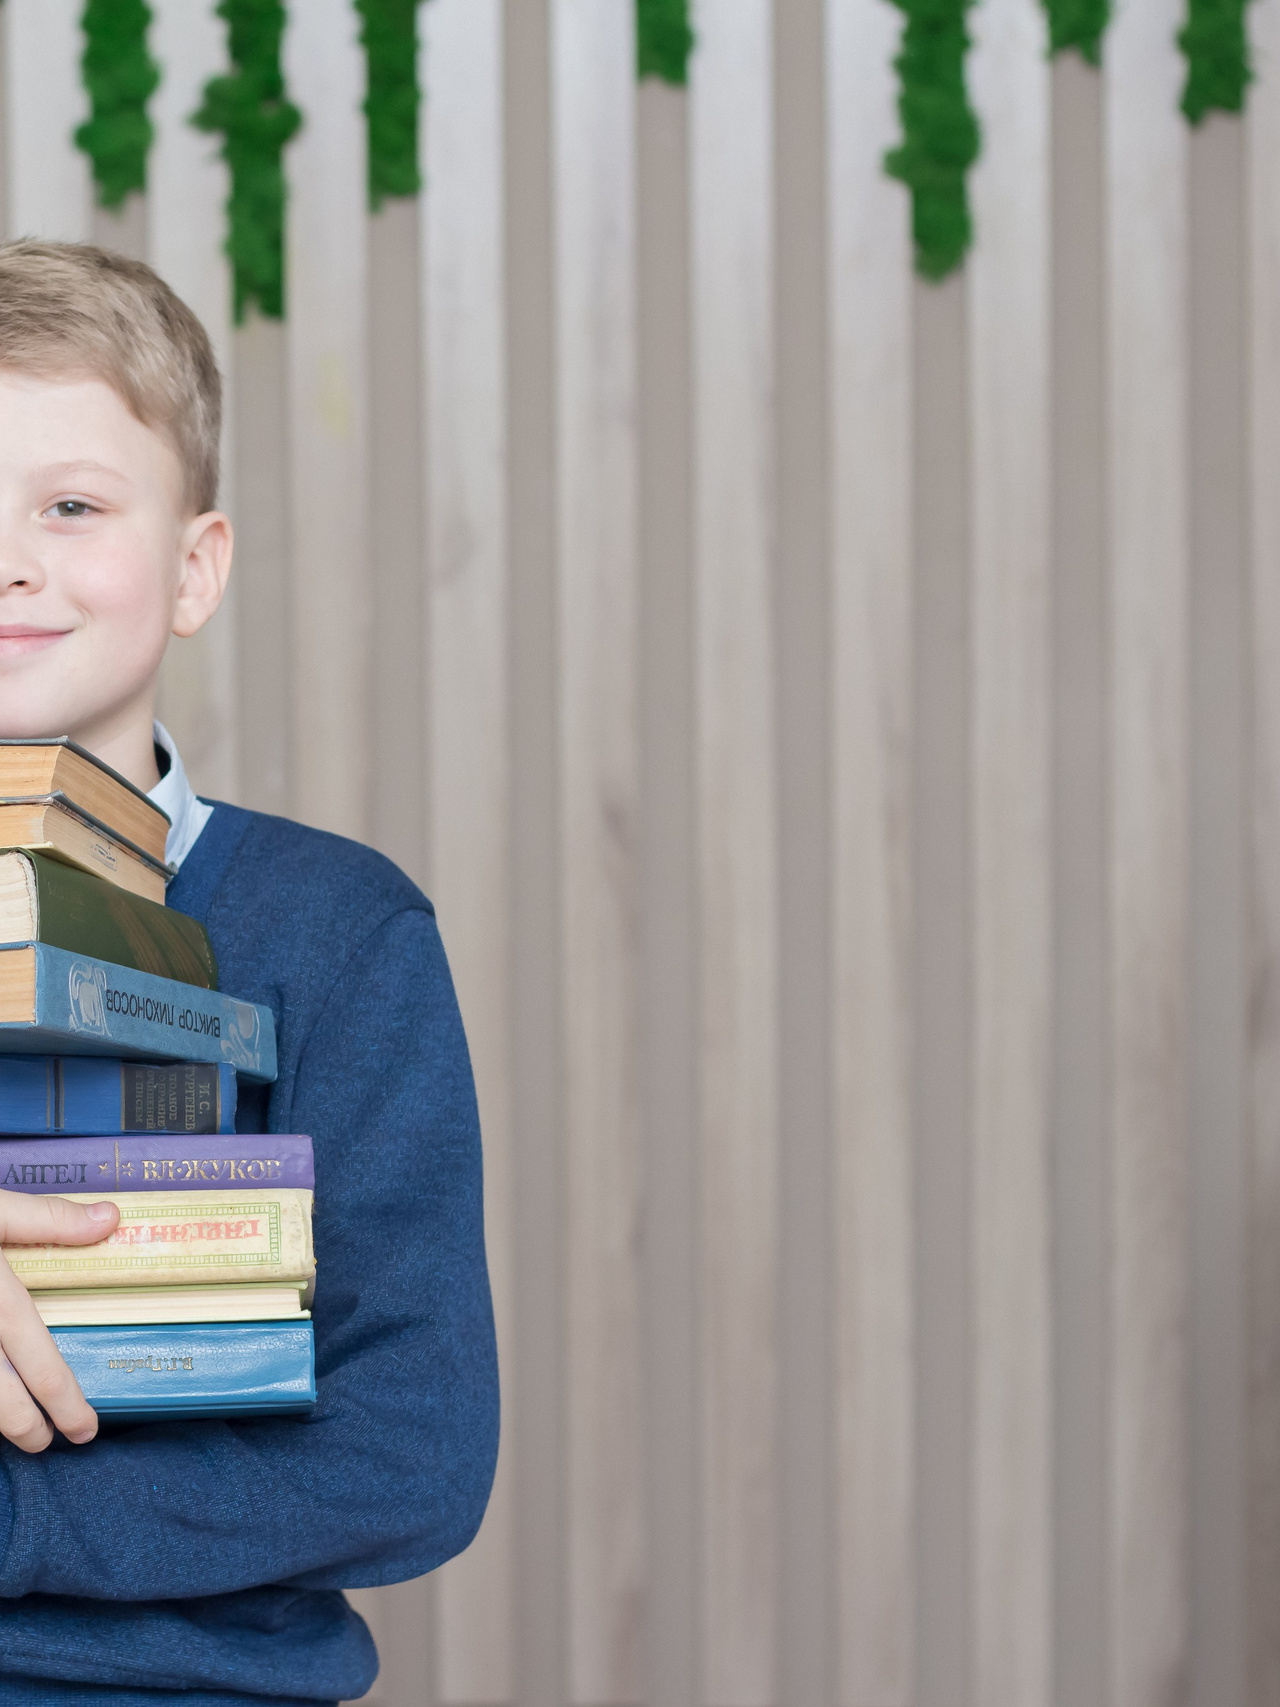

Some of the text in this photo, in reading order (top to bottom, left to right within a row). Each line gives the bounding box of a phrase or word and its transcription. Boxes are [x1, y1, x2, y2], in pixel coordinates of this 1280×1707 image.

[105, 989, 221, 1039] ВИКТОР ЛИХОНОСОВ
[146, 1069, 157, 1130] ОЧИНЕНИЙ
[157, 1070, 166, 1127] ОБРАНИЕ
[169, 1072, 178, 1121] ПОЛНОЕ
[185, 1065, 196, 1131] ТУРГЕНЕВ
[1, 1163, 88, 1186] АНГЕЛ
